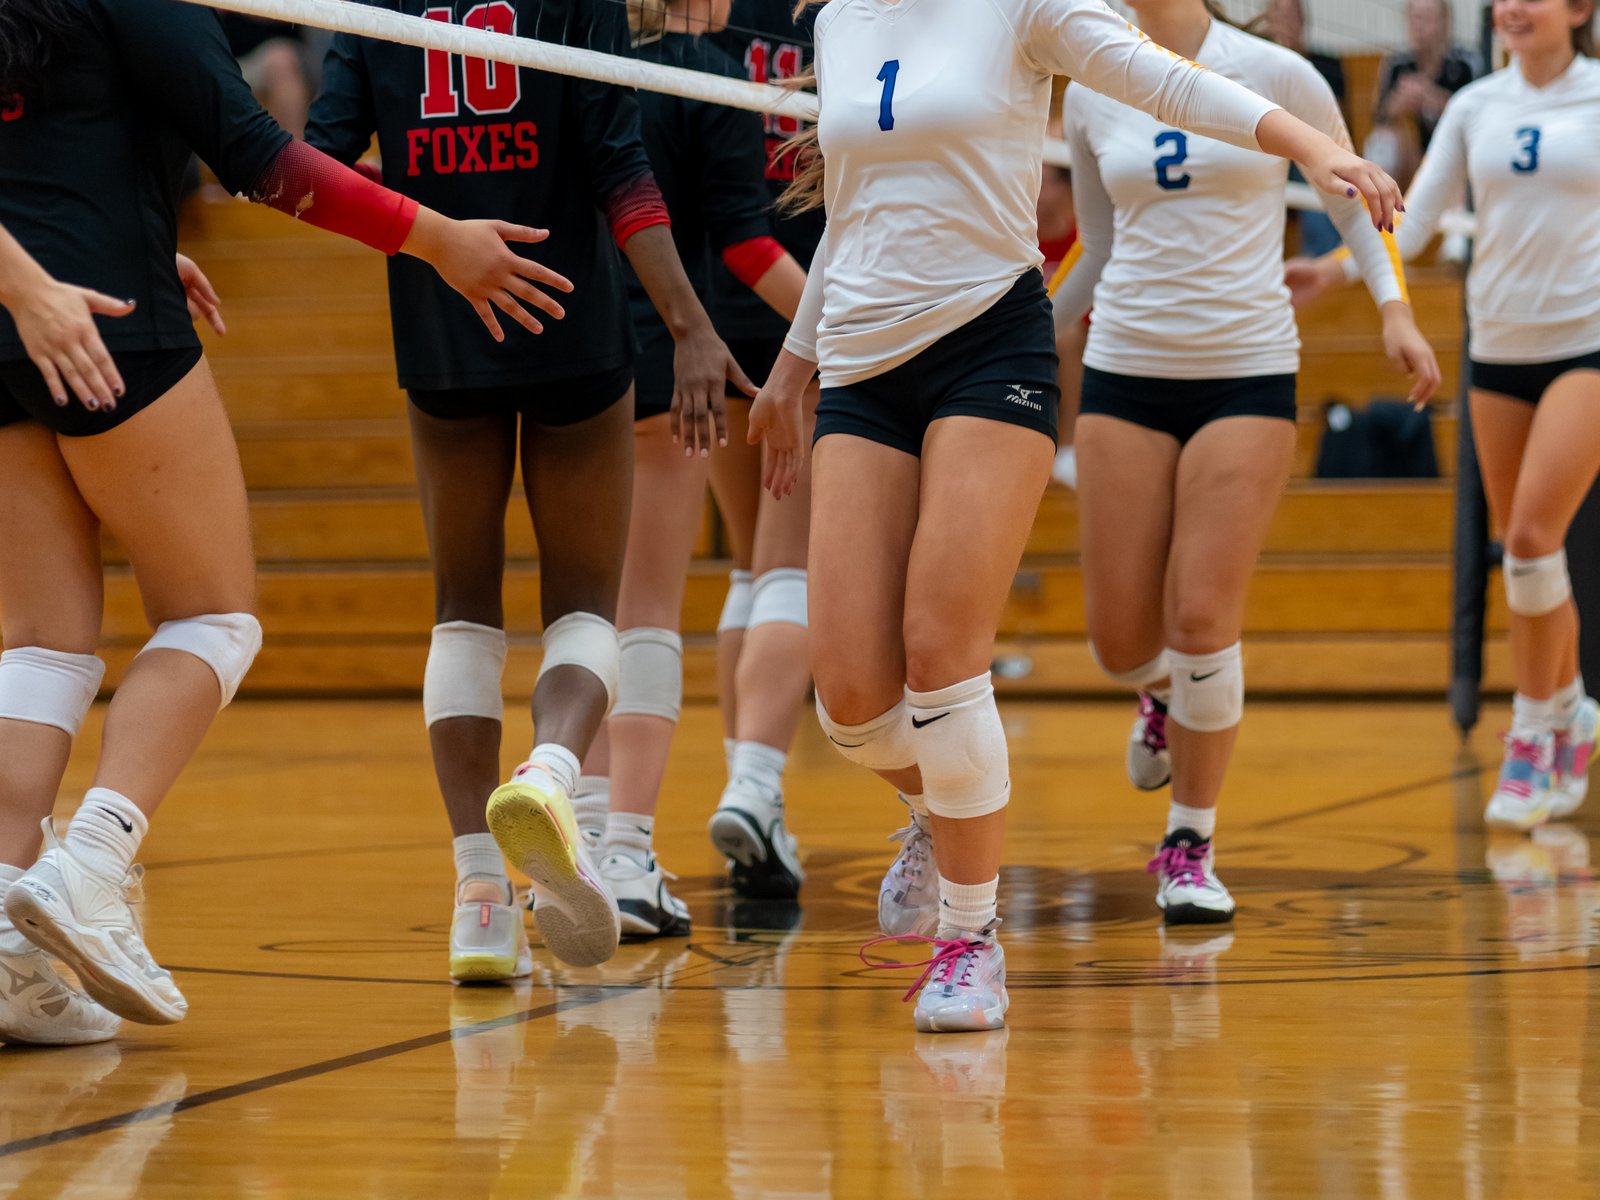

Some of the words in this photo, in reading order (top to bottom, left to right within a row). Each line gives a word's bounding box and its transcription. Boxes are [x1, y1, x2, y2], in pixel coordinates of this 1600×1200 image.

[421, 0, 521, 119] 10
[876, 59, 901, 132] 1
[406, 121, 539, 176] FOXES
[1154, 131, 1192, 190] 2
[1511, 126, 1541, 173] 3
